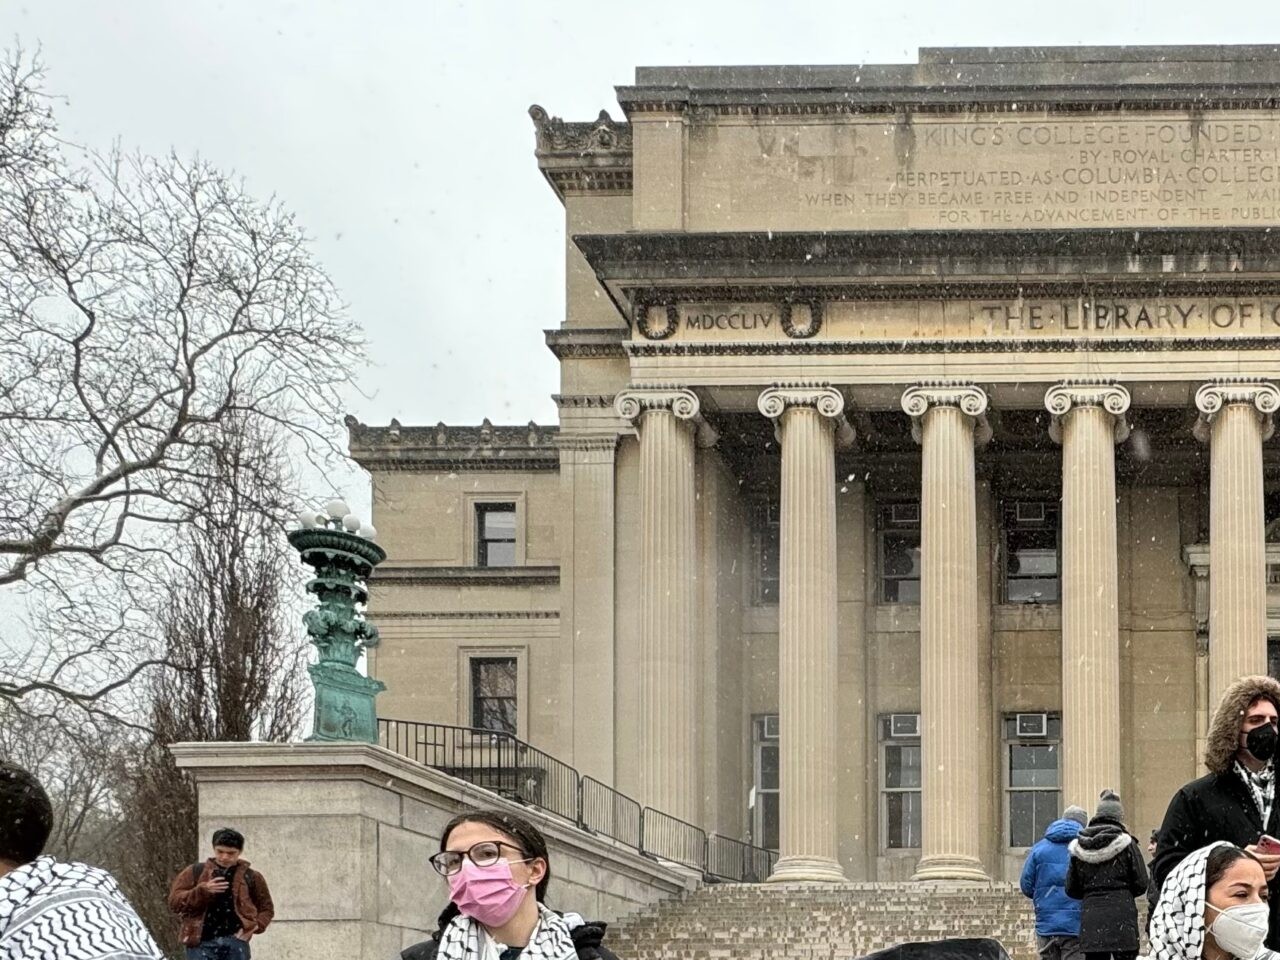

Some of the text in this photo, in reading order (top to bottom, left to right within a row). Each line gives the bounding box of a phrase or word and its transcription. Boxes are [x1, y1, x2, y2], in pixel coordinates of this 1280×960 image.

[1016, 125, 1131, 146] COLLEGE
[1144, 124, 1263, 144] FOUNDED
[1079, 149, 1101, 164] BY
[1112, 149, 1171, 164] ROYAL
[1180, 148, 1265, 163] CHARTER
[895, 170, 1022, 187] PERPETUATED
[1030, 170, 1053, 186] AS
[1061, 166, 1178, 186] COLUMBIA
[804, 193, 855, 207] WHEN
[864, 192, 909, 206] THEY
[918, 191, 983, 205] BECAME
[993, 191, 1033, 204] FREE
[1043, 190, 1079, 204] AND
[1089, 189, 1208, 203] INDEPENDENT
[938, 209, 971, 223] FOR
[1021, 207, 1149, 223] ADVANCEMENT
[1156, 207, 1179, 221] OF
[1187, 207, 1222, 220] THE
[685, 312, 774, 330] MDCCLIV
[982, 304, 1045, 331] THE
[1062, 303, 1197, 330] LIBRARY
[1210, 302, 1255, 329] OF
